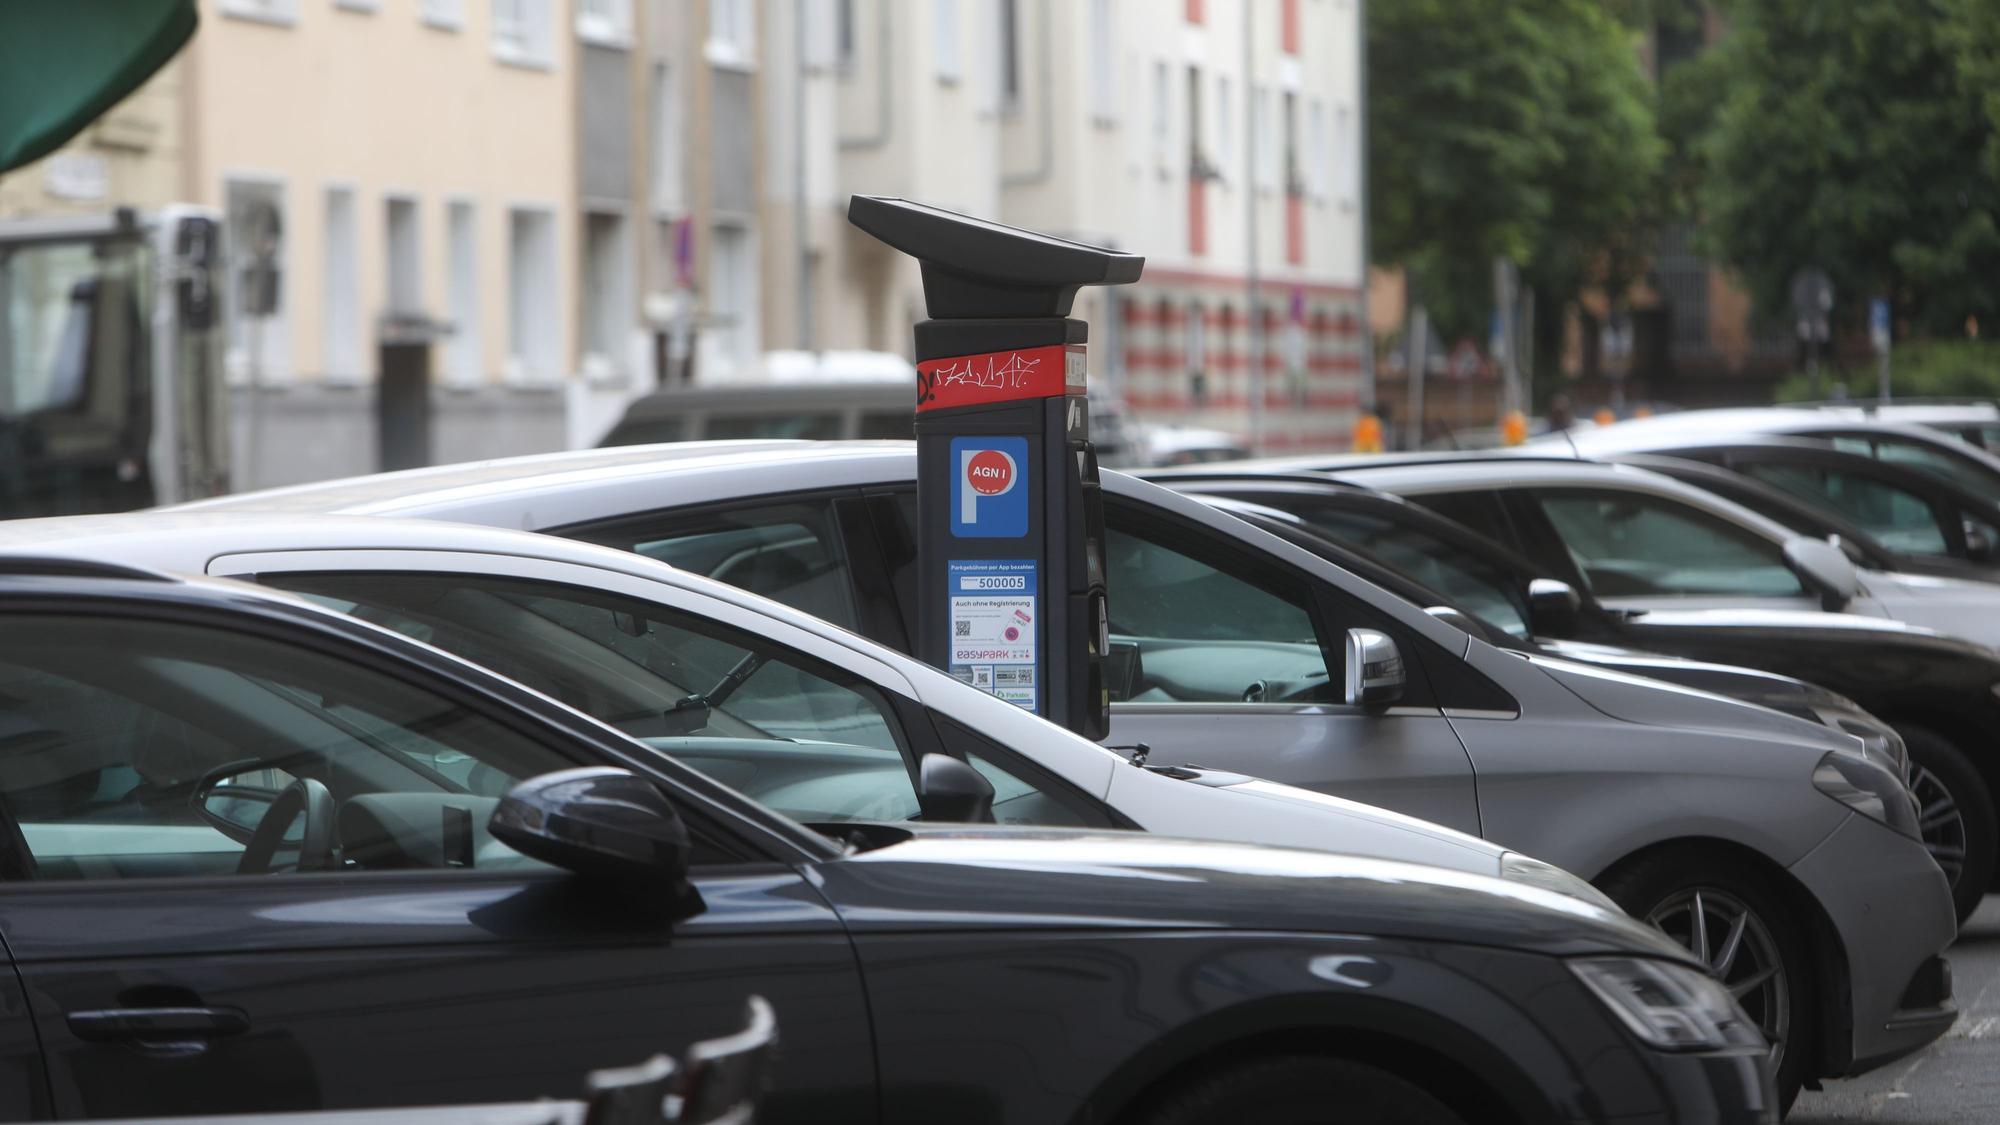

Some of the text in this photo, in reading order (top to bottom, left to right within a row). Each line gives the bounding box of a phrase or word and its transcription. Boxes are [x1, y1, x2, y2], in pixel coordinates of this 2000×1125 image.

[973, 466, 999, 479] AGN
[961, 450, 1018, 523] P
[979, 577, 1024, 588] 500005
